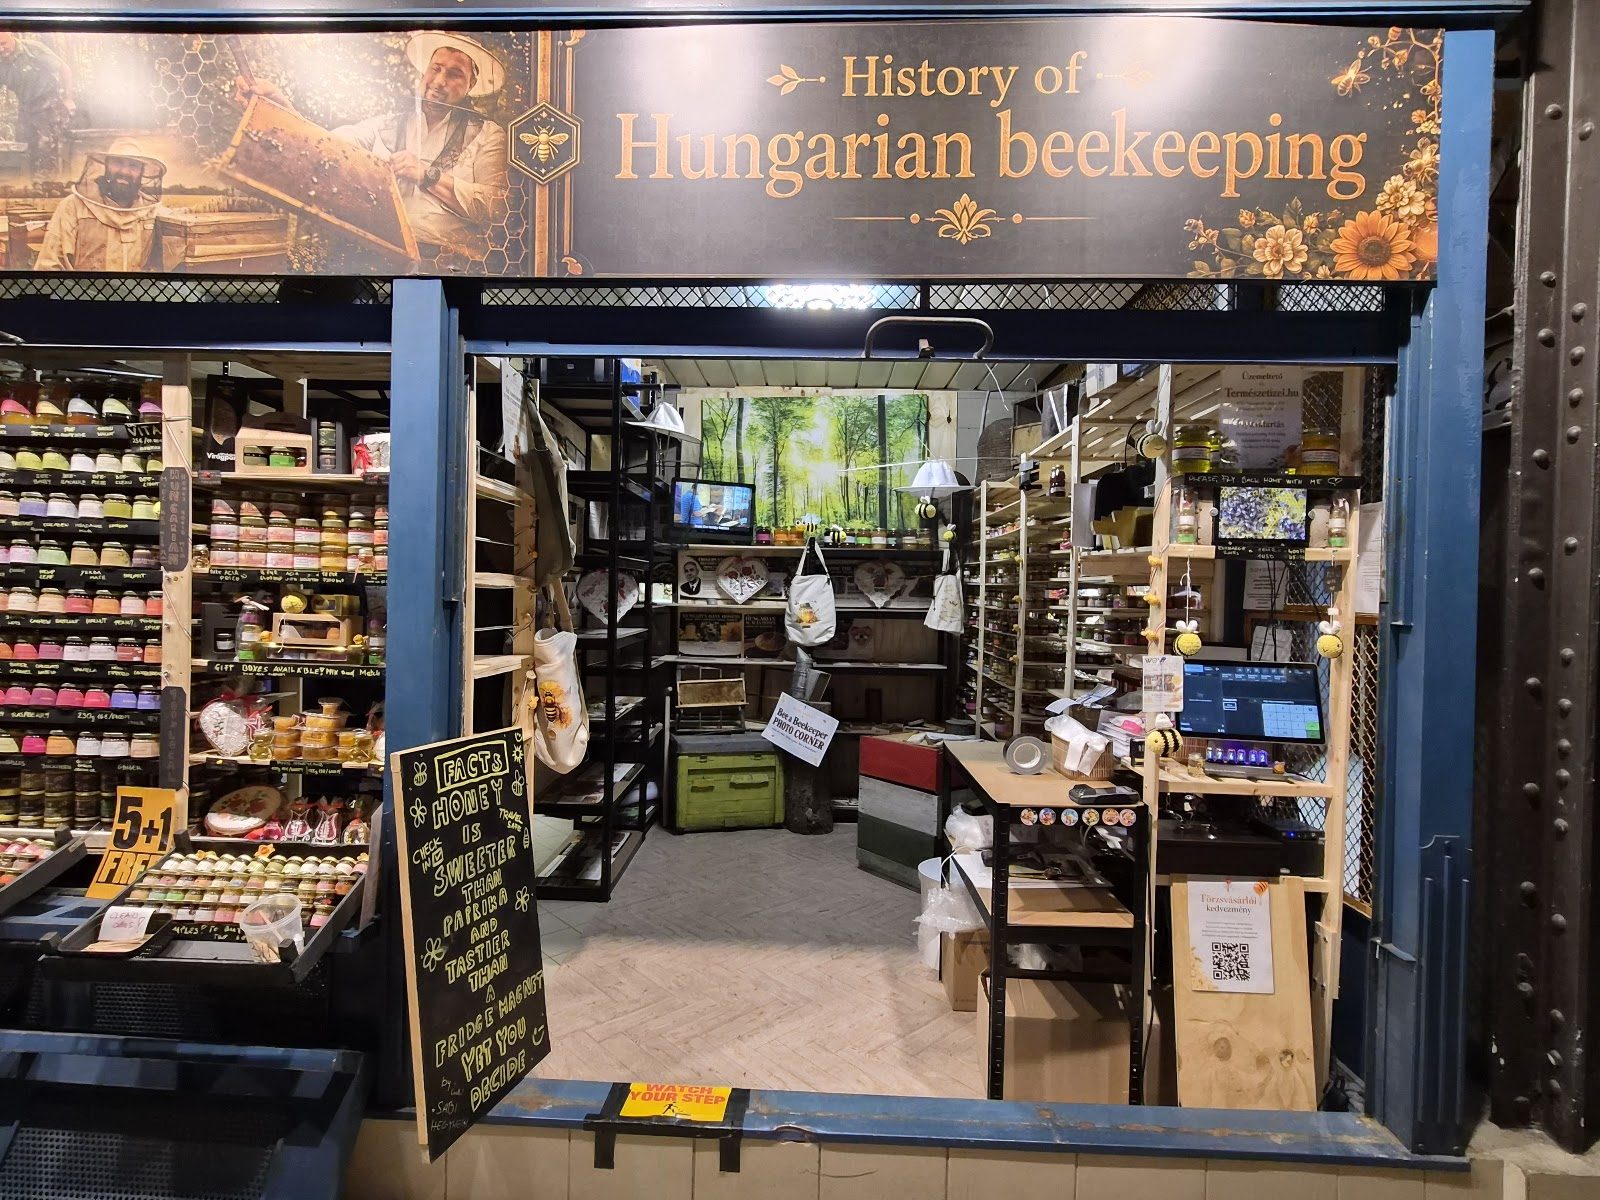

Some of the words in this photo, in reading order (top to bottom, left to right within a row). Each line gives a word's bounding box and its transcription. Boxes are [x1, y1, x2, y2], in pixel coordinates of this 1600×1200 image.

[842, 54, 1019, 107] History
[1034, 50, 1088, 96] of
[616, 112, 976, 199] Hungarian
[999, 108, 1368, 201] beekeeping
[242, 665, 269, 673] BOXES
[772, 716, 794, 735] PHOTO
[794, 729, 825, 751] CORNER
[777, 707, 789, 719] Bee
[792, 716, 829, 740] Beekeeper
[443, 751, 503, 786] FACTS
[432, 778, 503, 830] HONEY
[499, 807, 524, 825] TRAVEL
[113, 796, 172, 851] 5+1
[462, 822, 482, 845] IS
[507, 822, 522, 832] SAFE
[97, 850, 164, 885] FRE
[412, 837, 443, 865] CHECK
[422, 860, 433, 874] IN
[434, 835, 517, 897] SWEETER
[461, 868, 503, 905] THAN
[443, 887, 508, 938] PAPRIKA
[1206, 904, 1252, 915] kedvezmény
[470, 917, 498, 945] AND
[444, 929, 511, 985] TASTIER
[468, 953, 509, 993] THAN
[485, 984, 496, 1003] A
[435, 1007, 494, 1069] FRIDGE
[498, 970, 544, 1019] MAGNET
[461, 1038, 493, 1083] YET
[496, 1016, 527, 1057] YOU
[470, 1049, 526, 1113] DECIDE
[630, 1091, 677, 1102] YOUR
[682, 1093, 726, 1105] STEP
[646, 1083, 714, 1095] WATCH
